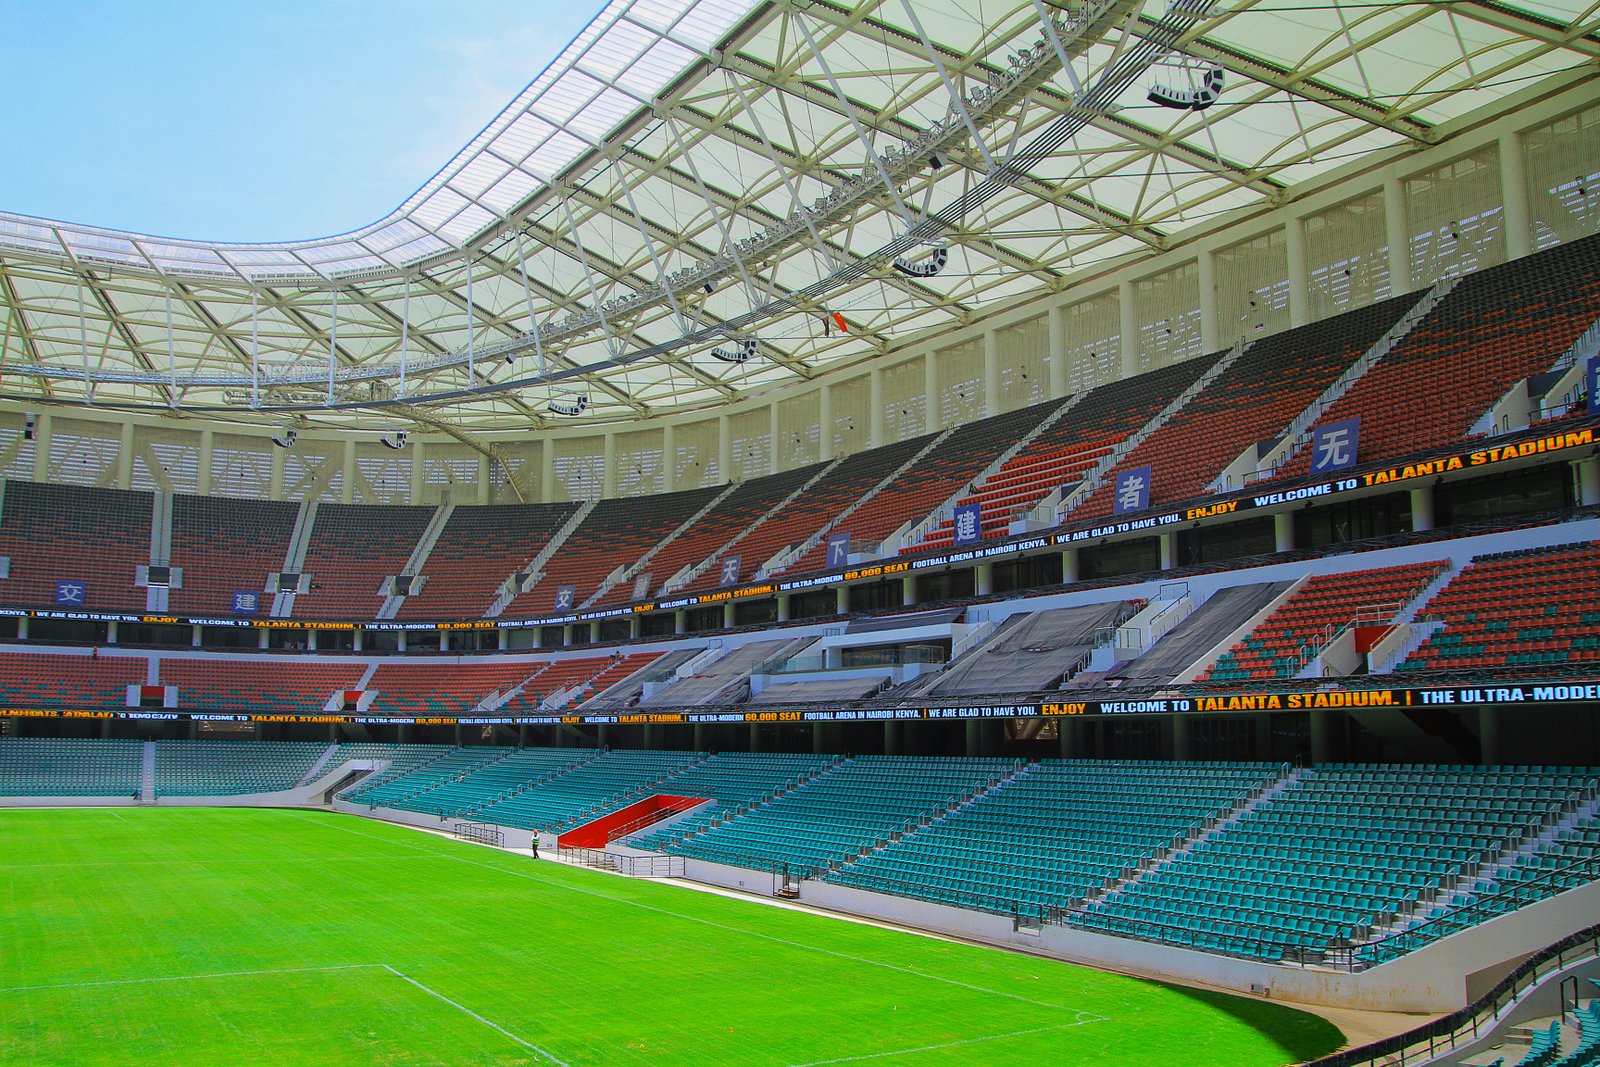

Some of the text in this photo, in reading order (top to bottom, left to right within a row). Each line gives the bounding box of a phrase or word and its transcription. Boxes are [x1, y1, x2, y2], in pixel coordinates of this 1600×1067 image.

[1317, 428, 1350, 470] 无
[1119, 476, 1144, 510] 者
[144, 615, 178, 623] ENJOY
[189, 617, 234, 626] WELCOME
[252, 620, 301, 628] TALANTA
[634, 603, 654, 611] ENJOY
[660, 599, 688, 609] WELCOME
[699, 592, 731, 603] TALANTA
[734, 585, 773, 598] STADIUM.
[780, 582, 791, 591] THE
[793, 574, 843, 589] ULTRA-MODERN
[884, 562, 909, 574] SEAT
[913, 555, 947, 569] FOOTBALL
[950, 551, 973, 563] ARENA
[985, 544, 1016, 557] NAIROBI
[1018, 538, 1047, 552] KENYA.
[1057, 533, 1070, 544] WE
[1072, 529, 1089, 541] ARE
[1092, 524, 1115, 537] GLAD
[1118, 522, 1129, 532] TO
[1132, 517, 1155, 530] HAVE
[1158, 512, 1181, 525] YOU.
[1187, 501, 1238, 520] ENJOY
[1254, 483, 1331, 507] WELCOME
[1336, 477, 1357, 491] TO
[1363, 455, 1462, 485] TALANTA
[1470, 430, 1600, 465] STADIUM.
[956, 510, 976, 542] 建
[830, 540, 846, 564] 下
[722, 559, 737, 583] 天
[60, 584, 81, 602] 交
[236, 594, 256, 610] 建
[649, 714, 683, 722] STADIUM.
[780, 712, 801, 721] SEAT
[804, 712, 834, 720] FOOTBALL
[836, 711, 856, 720] ARENA
[866, 710, 894, 720] NAIROBI
[896, 710, 921, 719] KENYA.
[929, 708, 940, 718] WE
[942, 708, 957, 717] ARE
[959, 707, 978, 717] GLAD
[981, 707, 991, 716] TO
[994, 706, 1014, 716] HAVE
[1017, 705, 1038, 716] YOU.
[1042, 703, 1086, 715] ENJOY
[1101, 699, 1167, 713] WELCOME
[1172, 699, 1189, 712] TO
[1196, 695, 1279, 711] TALANTA
[1288, 691, 1399, 709] STADIUM.
[1421, 691, 1454, 704] THE
